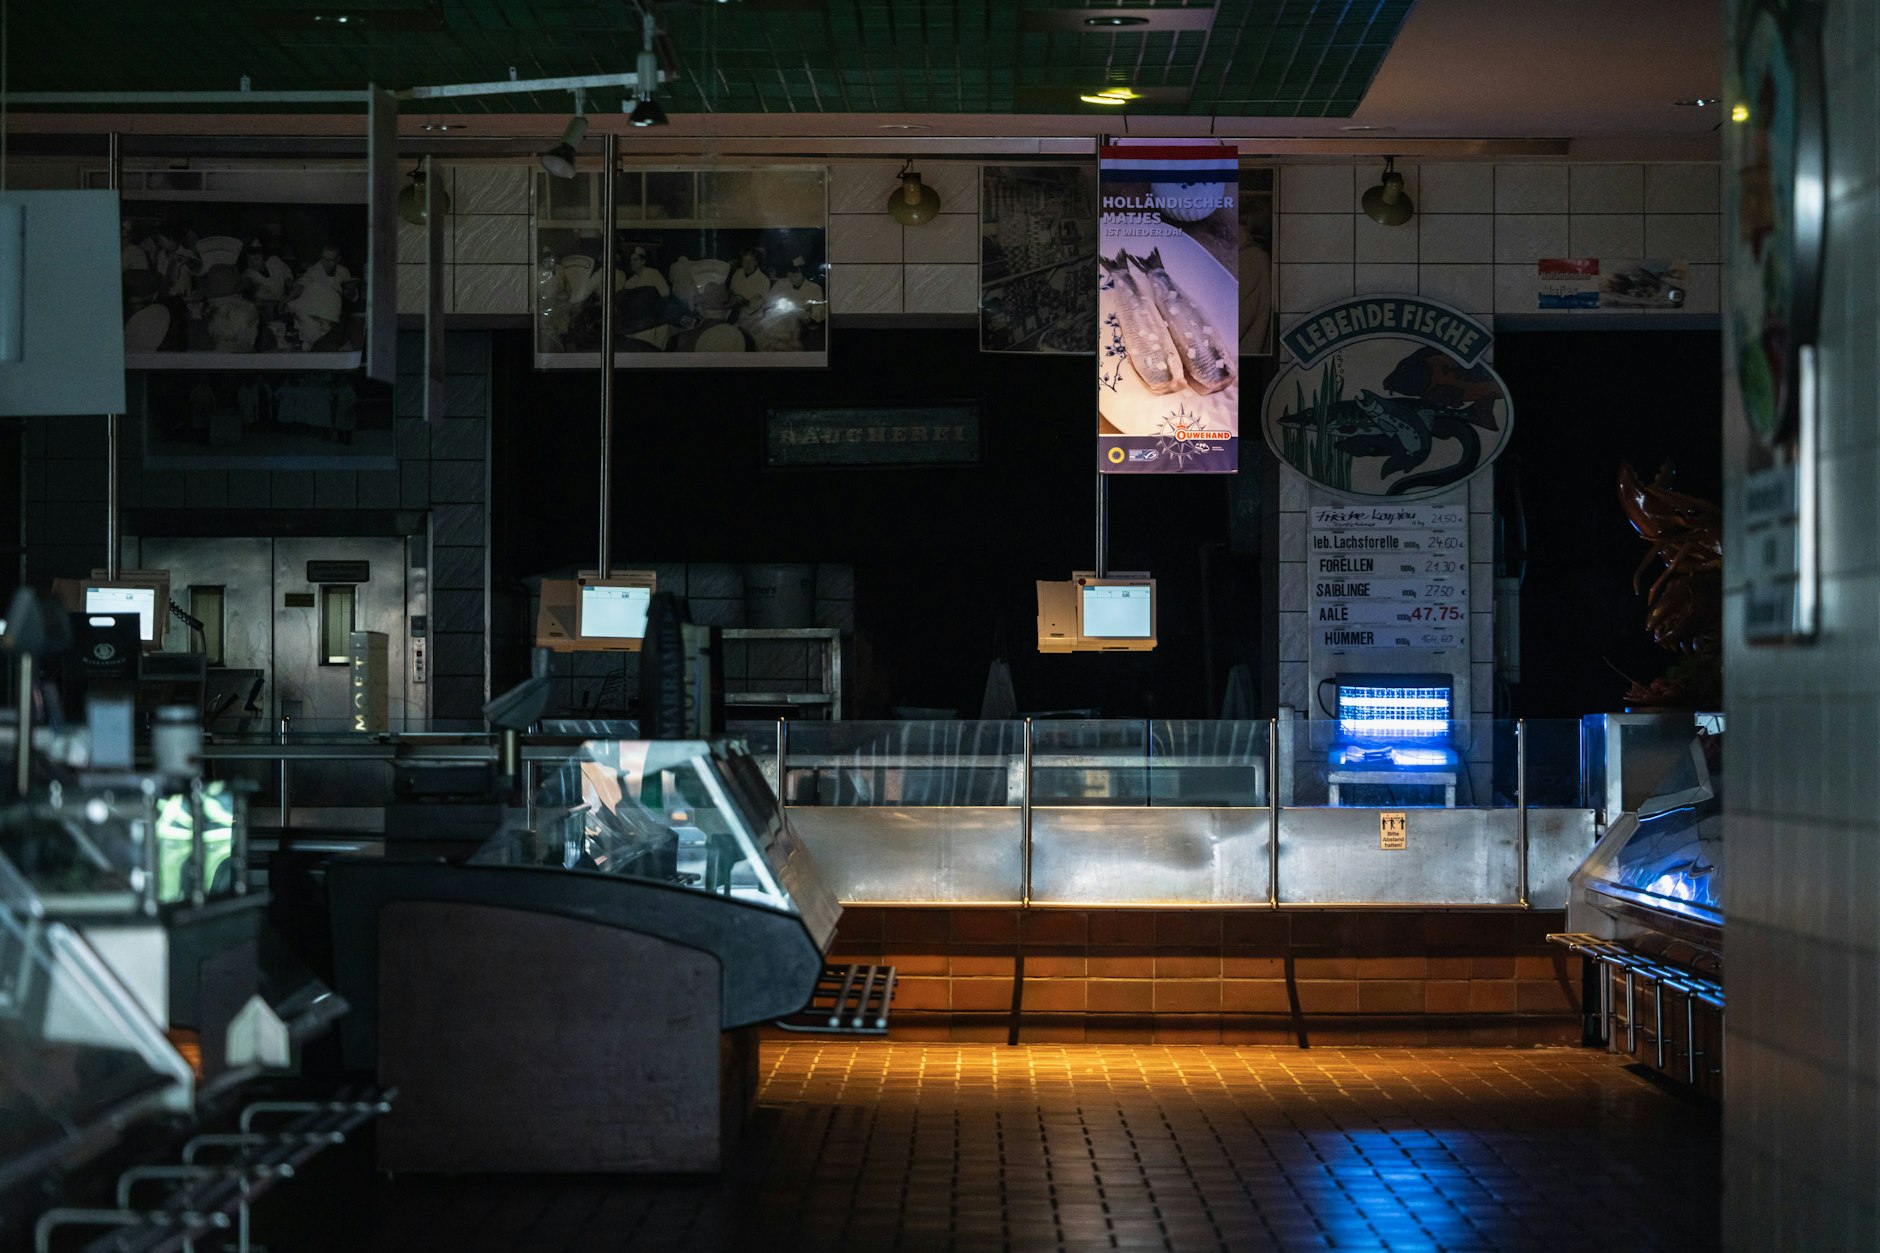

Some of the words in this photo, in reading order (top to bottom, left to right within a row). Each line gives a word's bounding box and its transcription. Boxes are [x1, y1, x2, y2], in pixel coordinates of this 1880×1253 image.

[1102, 193, 1234, 209] HOLLÄNDISCHER
[1102, 211, 1162, 226] MATJES
[1105, 227, 1120, 238] IST
[1123, 227, 1163, 238] WIEDER
[1295, 302, 1396, 354] LEBENDE
[1401, 303, 1480, 354] FISCHE
[1176, 429, 1230, 441] OUWEHAND
[1313, 535, 1332, 548] leb.
[1335, 535, 1399, 548] Lachsforelle
[1319, 558, 1374, 572] FORELLEN
[1316, 583, 1371, 597] SAIBLINGE
[1319, 607, 1349, 621] AALE
[1325, 631, 1374, 645] HUMMER
